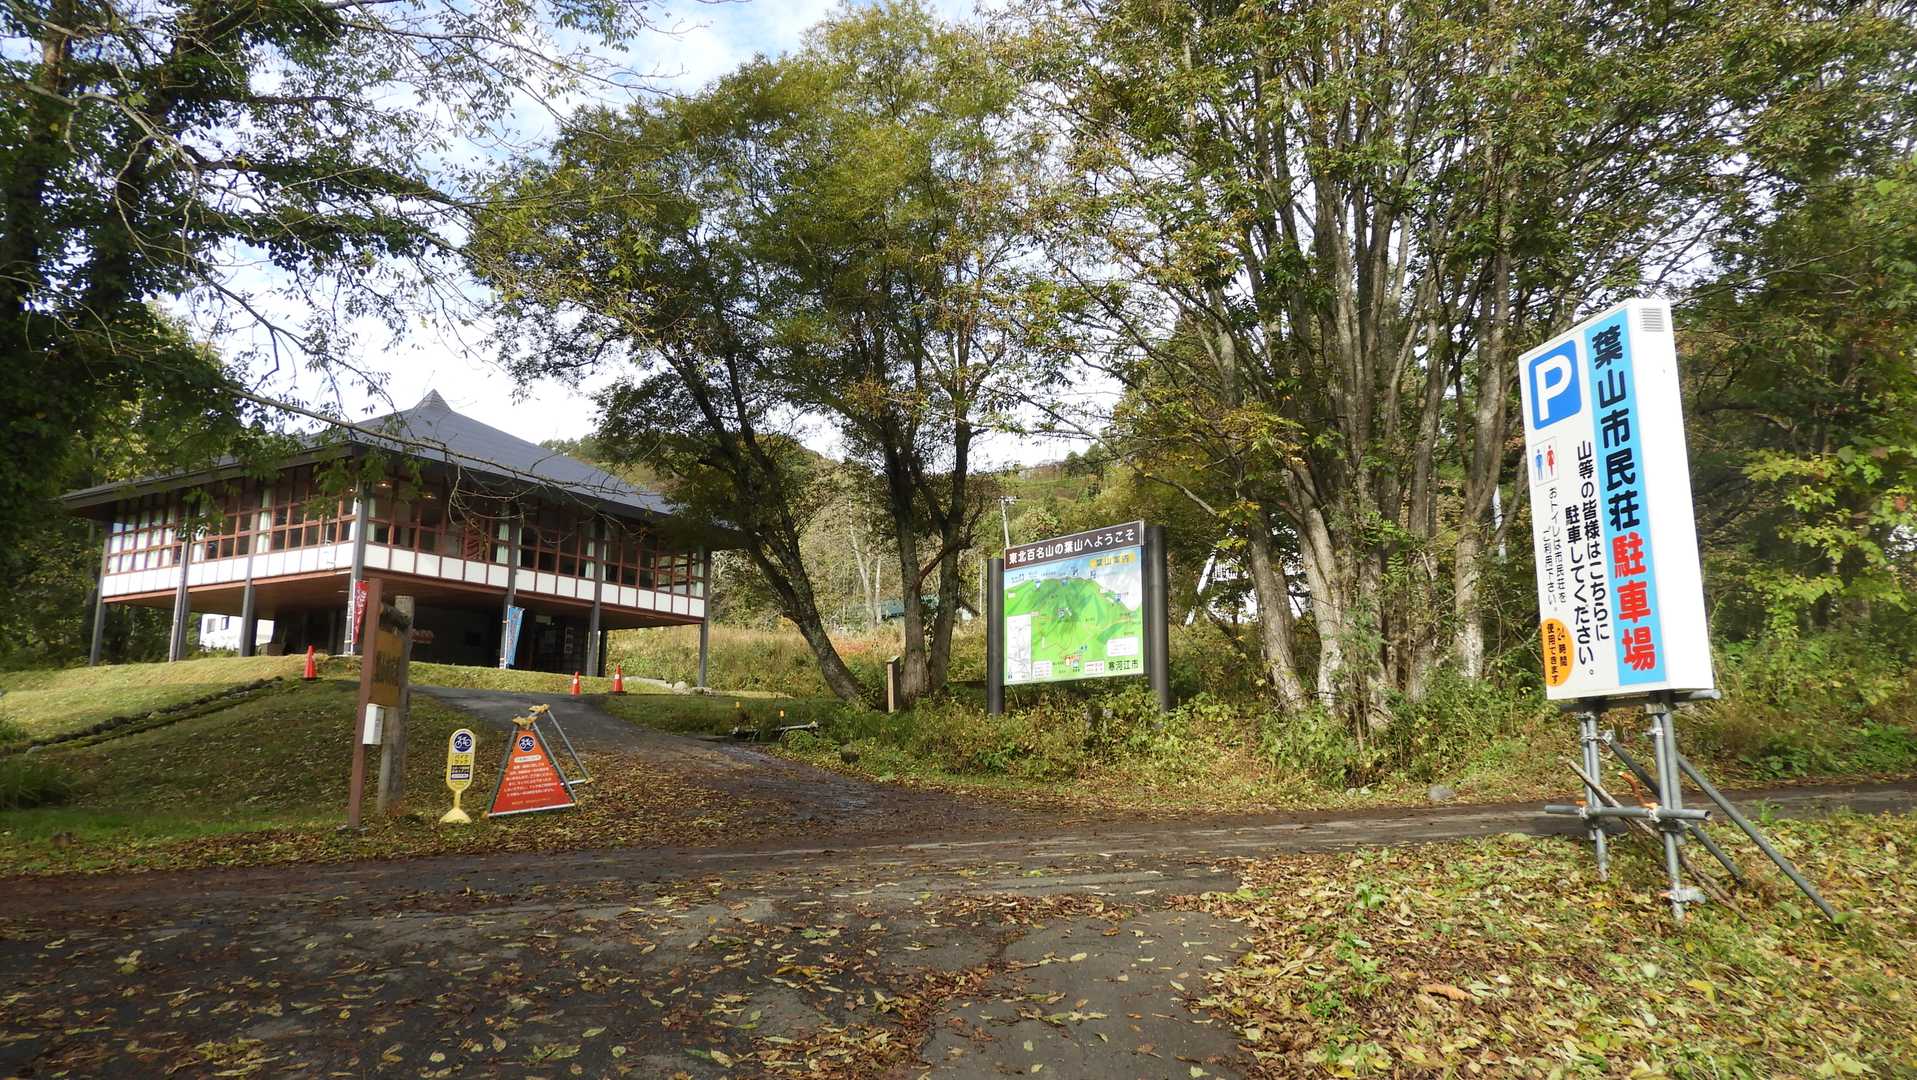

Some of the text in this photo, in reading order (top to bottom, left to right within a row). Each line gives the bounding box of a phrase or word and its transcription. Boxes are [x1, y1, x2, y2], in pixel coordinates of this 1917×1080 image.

[1535, 354, 1573, 422] P
[1008, 528, 1136, 565] 東北百名山の葉山へようこそ
[1577, 440, 1610, 641] 山等の皆様はこちらに
[1565, 505, 1595, 676] 駐車してください。
[1108, 658, 1139, 672] 寒河江市
